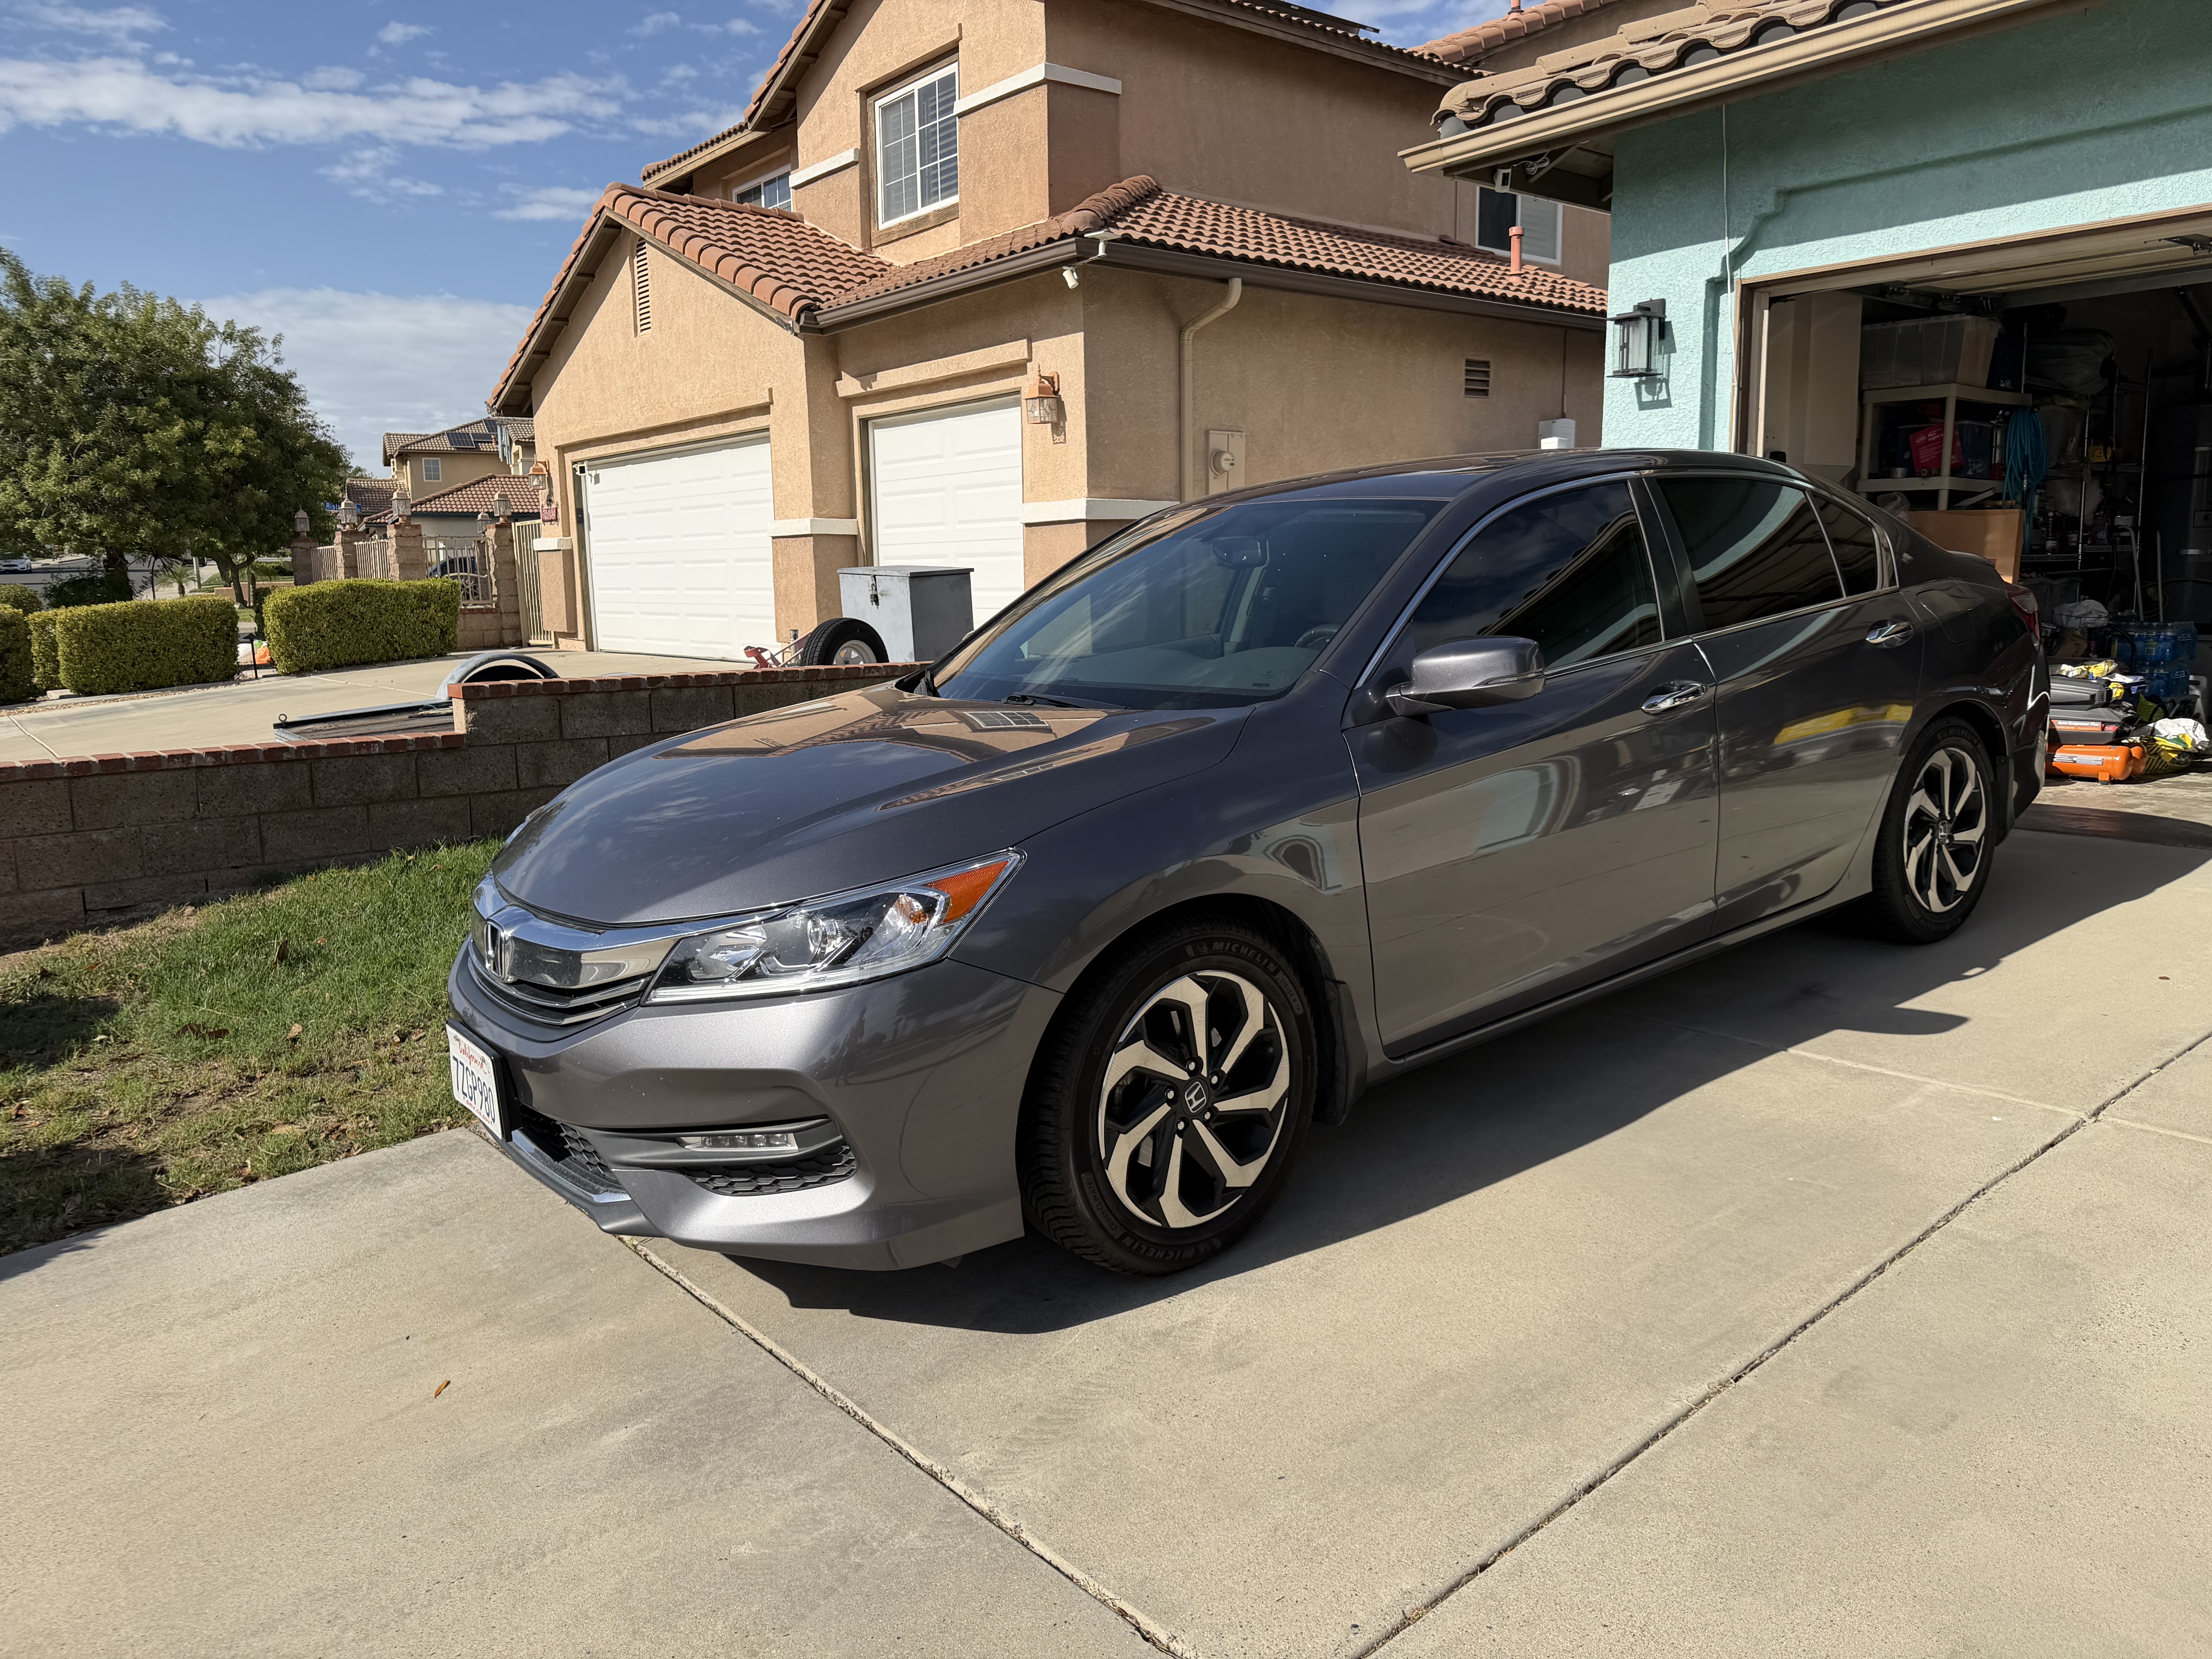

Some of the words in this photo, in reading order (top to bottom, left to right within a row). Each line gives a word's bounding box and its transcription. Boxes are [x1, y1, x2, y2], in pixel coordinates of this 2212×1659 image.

[1212, 941, 1277, 973] MICHELIN
[452, 1055, 495, 1123] 7ZGP980
[1122, 1235, 1194, 1259] MICHELIN
